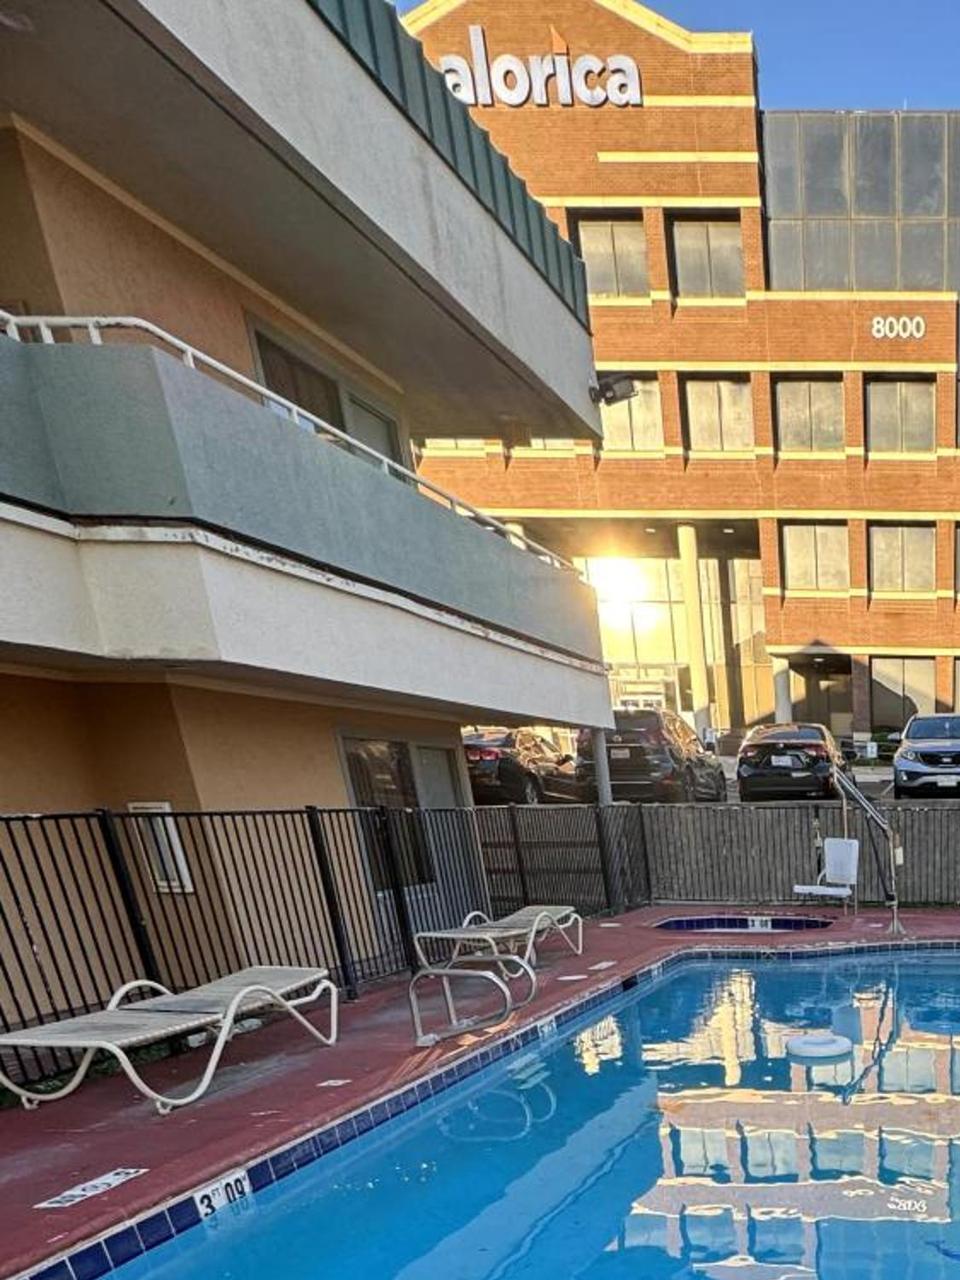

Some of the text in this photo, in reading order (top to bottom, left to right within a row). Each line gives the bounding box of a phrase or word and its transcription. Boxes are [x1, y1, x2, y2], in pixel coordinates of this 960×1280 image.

[439, 24, 643, 107] alorica
[872, 316, 925, 338] 8000
[200, 1194, 216, 1217] 3
